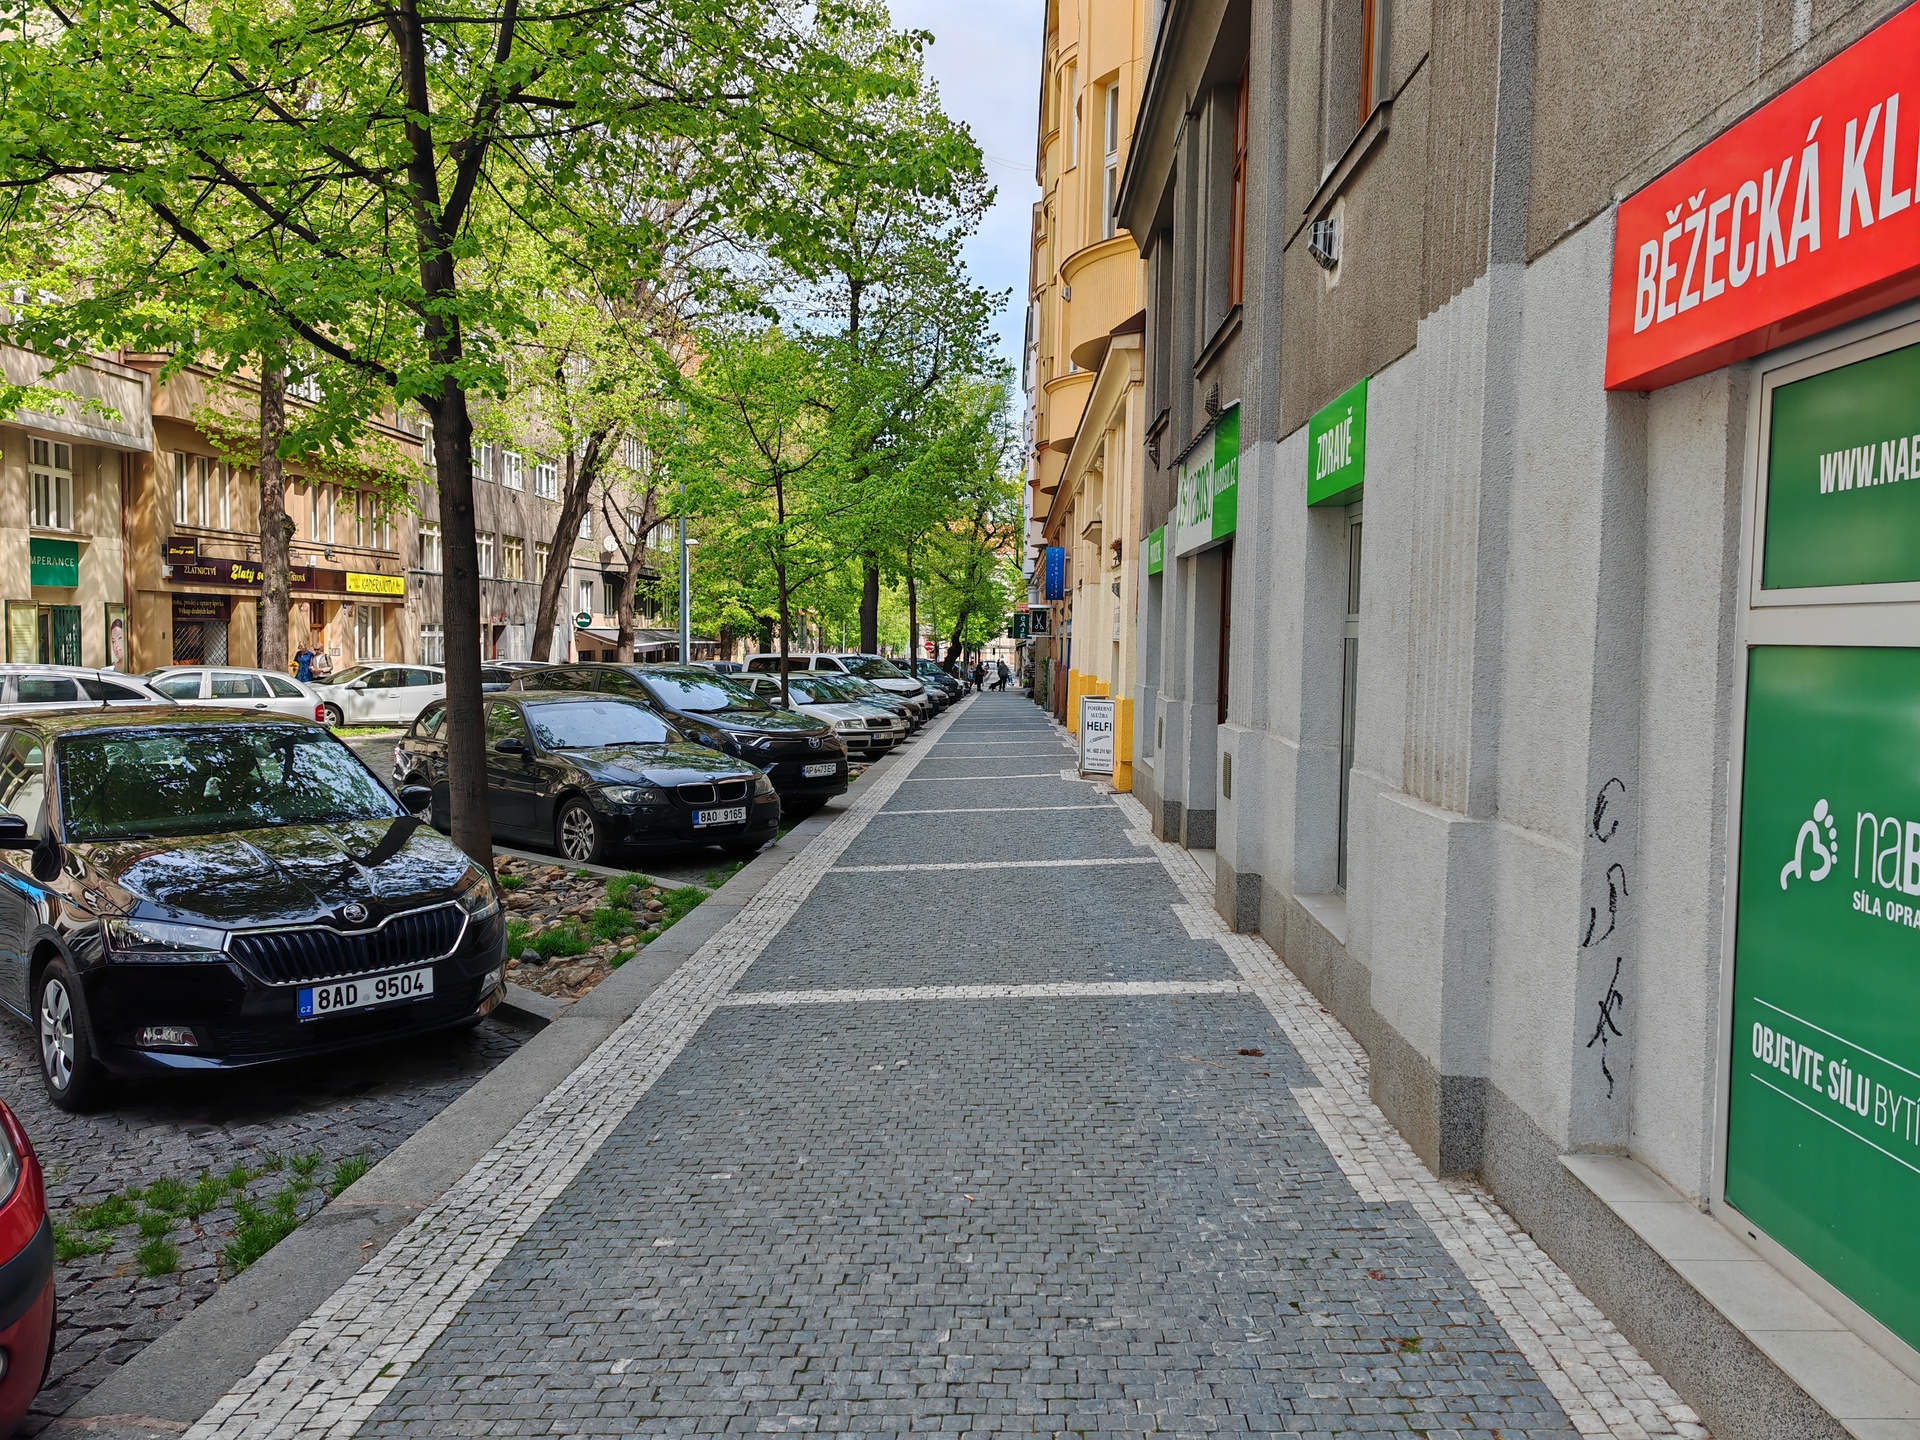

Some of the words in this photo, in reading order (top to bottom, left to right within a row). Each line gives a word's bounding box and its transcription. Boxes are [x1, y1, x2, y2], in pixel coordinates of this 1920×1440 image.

[1634, 115, 1823, 335] BĚŽECKÁ
[1316, 405, 1353, 481] ZDRAVĚ
[1820, 434, 1920, 494] WWW.NAB
[183, 565, 217, 577] ZLATNICTVÍ
[231, 564, 255, 583] Zlatý
[1086, 721, 1112, 732] HELFI
[723, 808, 743, 821] 9165
[1852, 889, 1882, 918] SÍLA
[318, 983, 358, 1010] 8AD
[375, 972, 424, 1000] 9504
[300, 1005, 312, 1014] CZ
[1752, 1022, 1824, 1093] OBJEVTE
[1827, 1058, 1870, 1117] SÍLU
